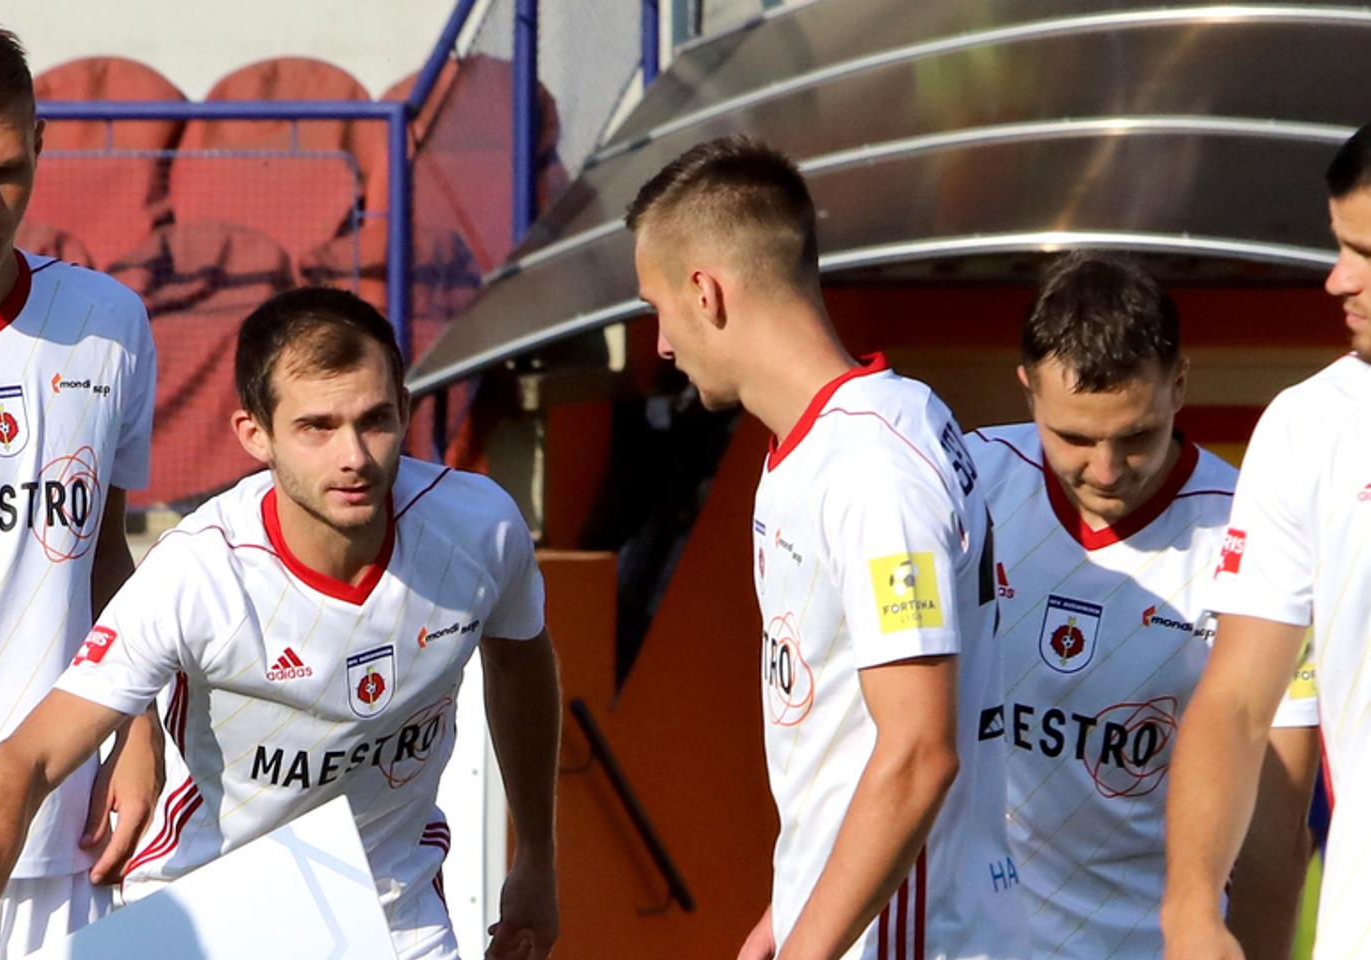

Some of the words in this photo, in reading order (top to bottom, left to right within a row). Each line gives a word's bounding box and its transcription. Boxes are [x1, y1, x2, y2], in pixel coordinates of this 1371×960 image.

[59, 378, 91, 389] mondi
[1151, 616, 1193, 632] mondi
[266, 667, 313, 682] adidas
[250, 714, 441, 789] MAESTRO
